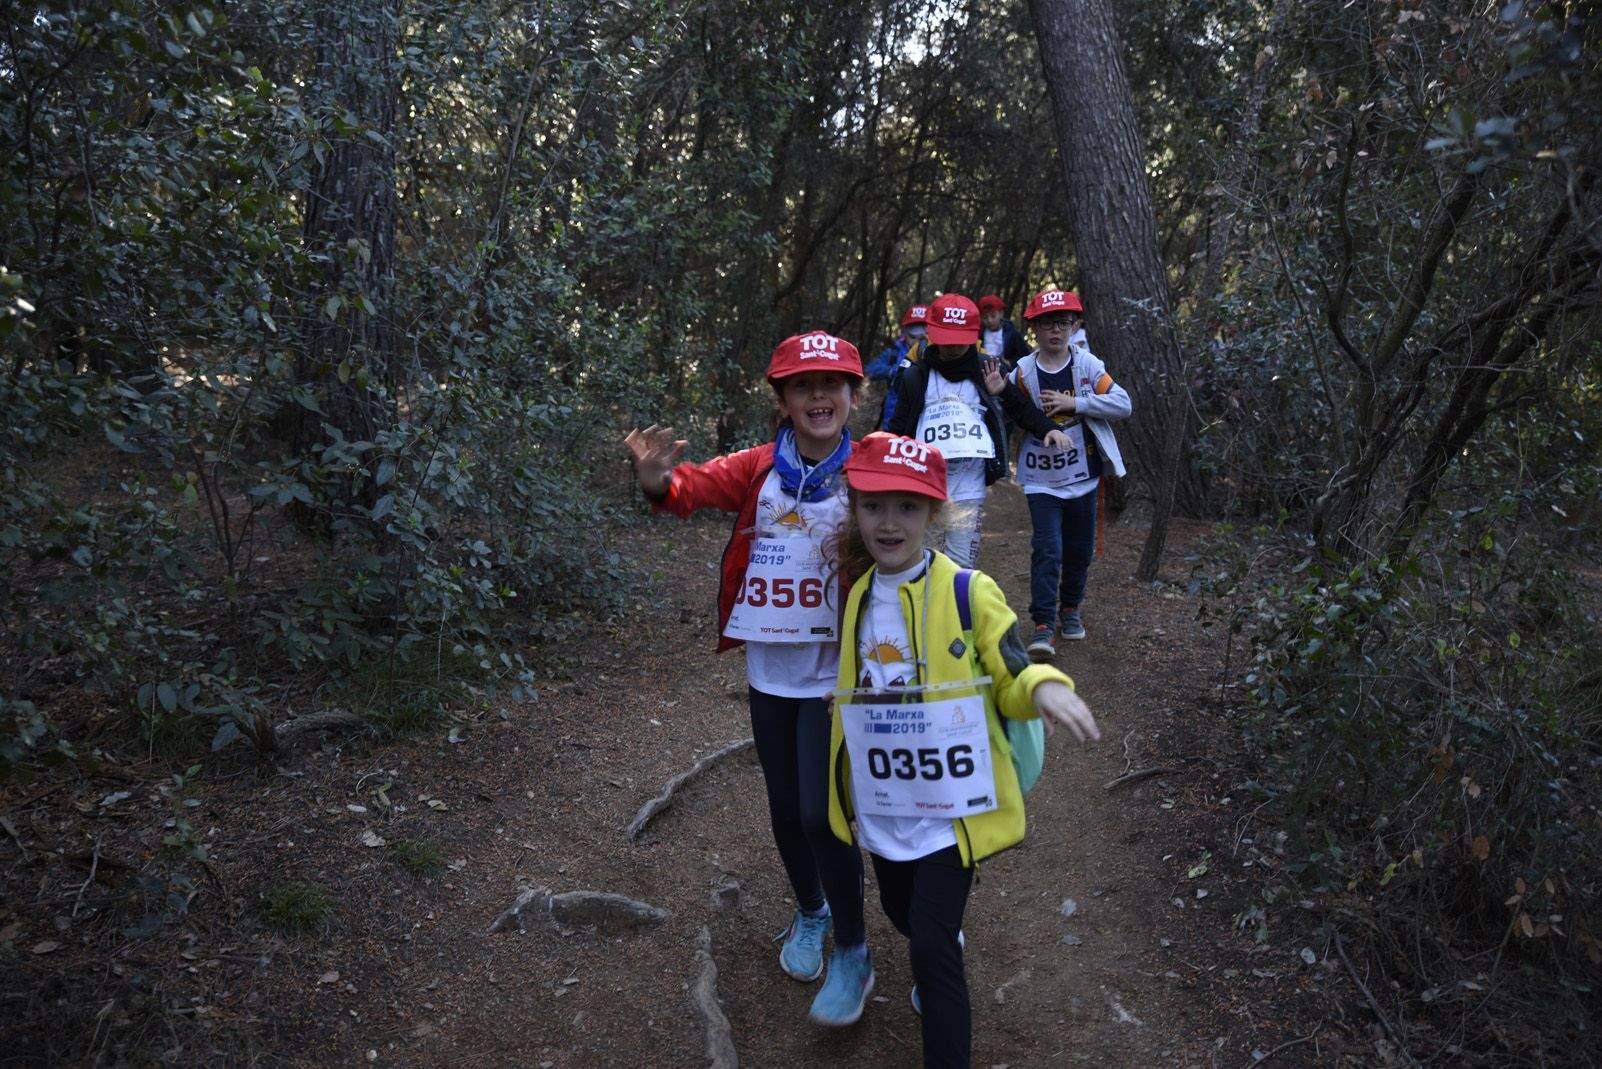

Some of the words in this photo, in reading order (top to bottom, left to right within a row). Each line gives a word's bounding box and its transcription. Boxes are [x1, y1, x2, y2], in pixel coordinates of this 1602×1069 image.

[1042, 291, 1065, 303] TOT
[943, 307, 968, 319] TOT
[800, 334, 839, 352] TOT
[924, 423, 983, 444] 0354
[888, 438, 931, 463] TOT
[1026, 448, 1079, 470] 0352
[886, 709, 925, 720] Marxa
[868, 744, 975, 781] 0356
